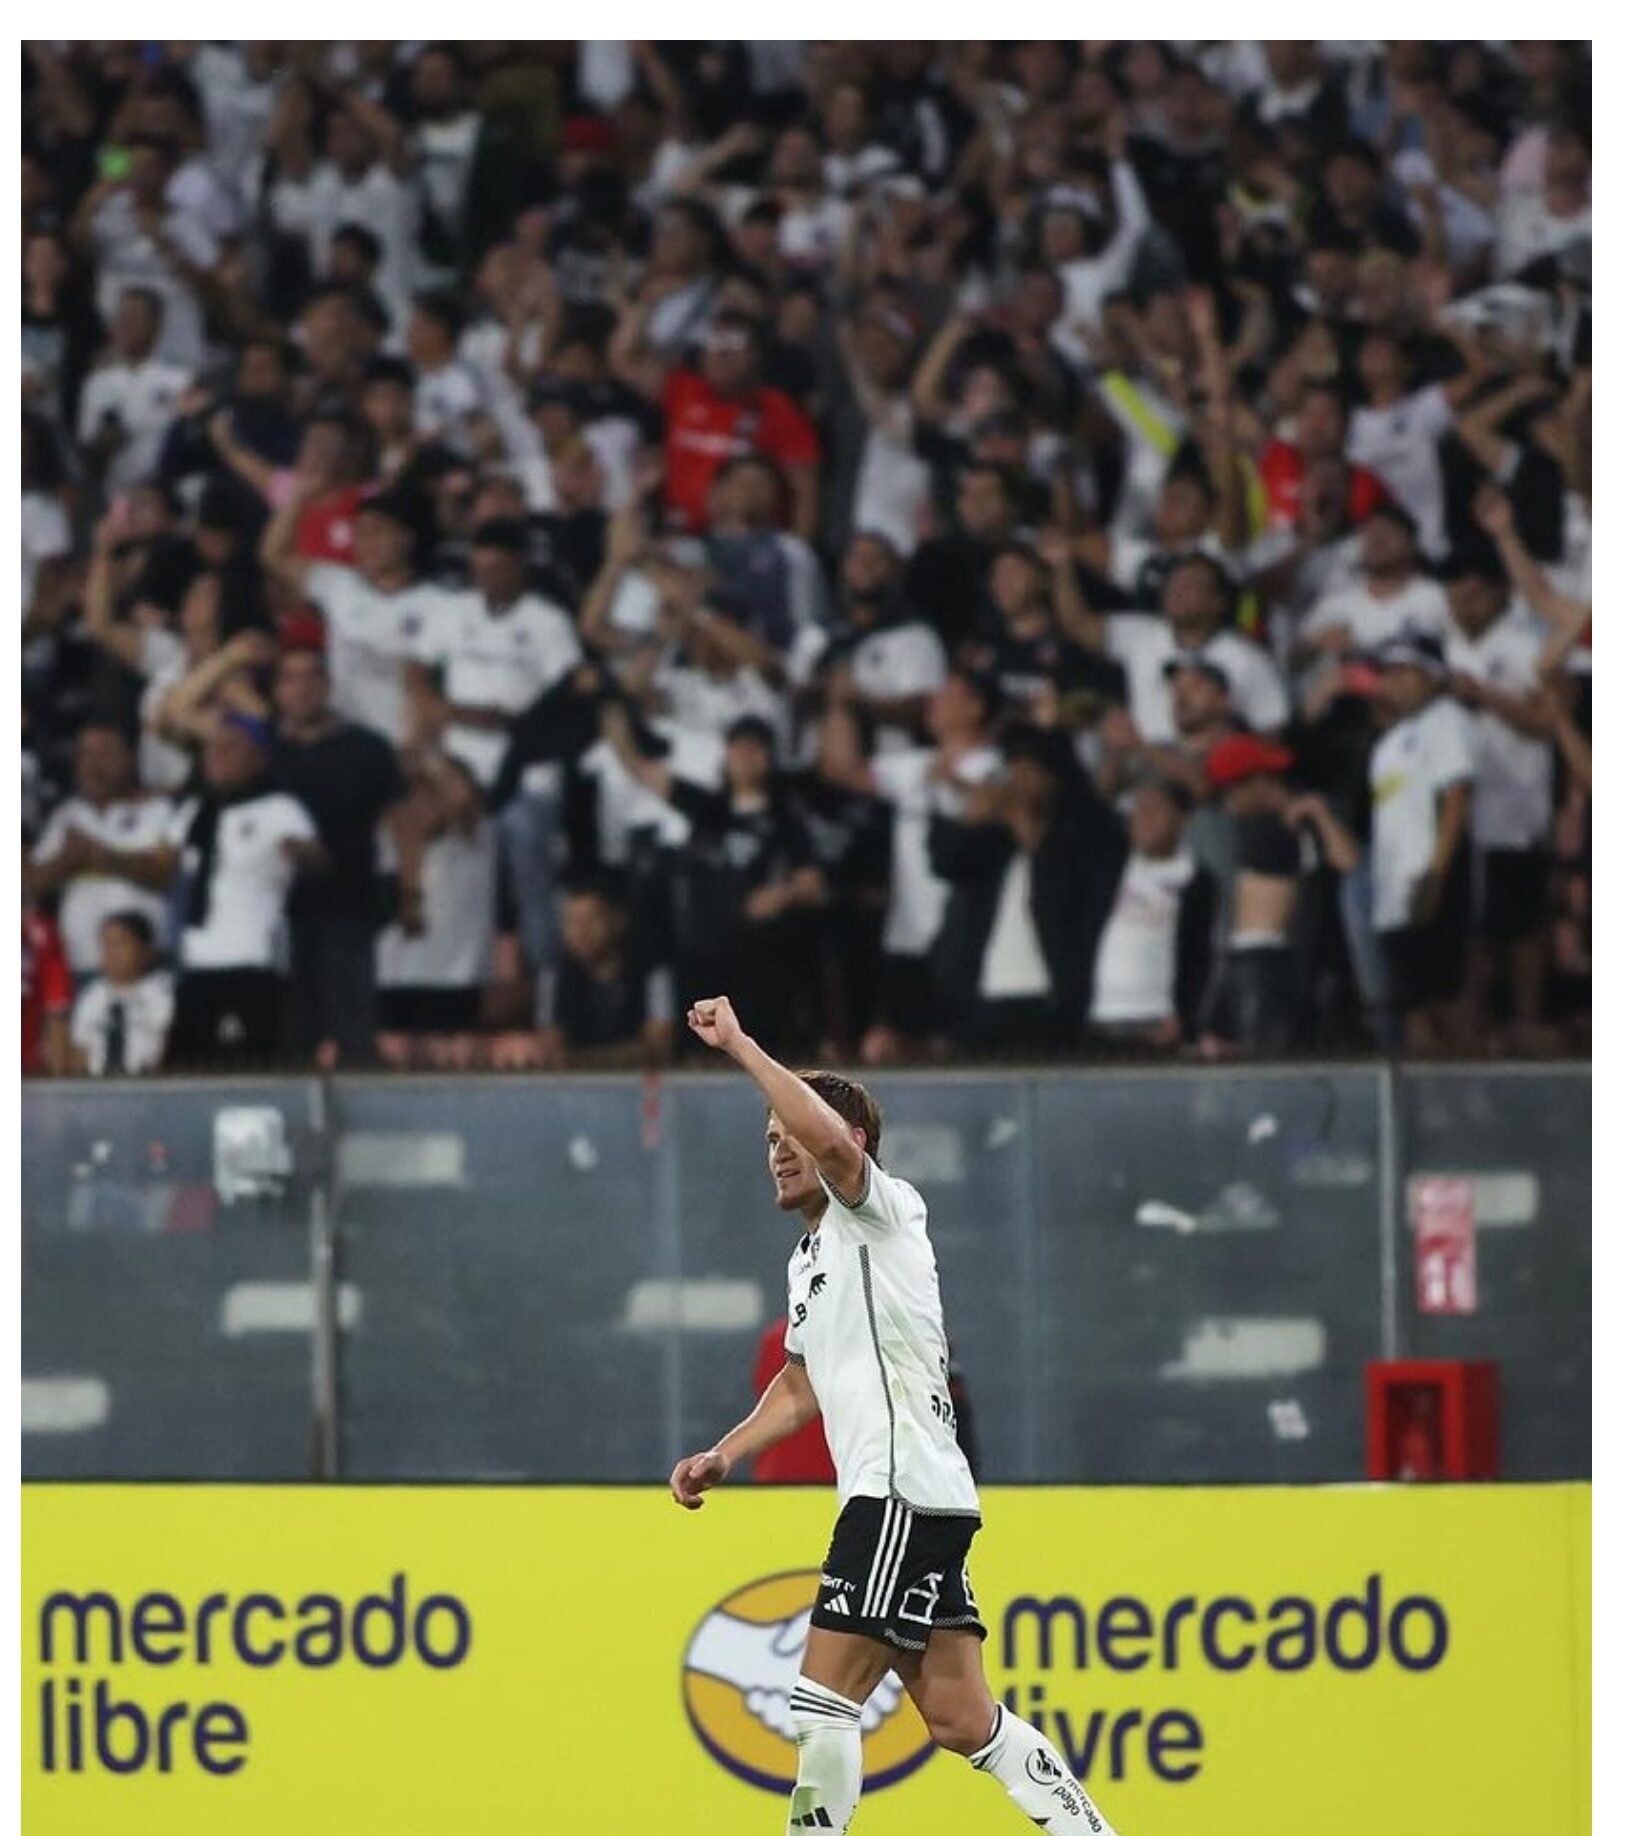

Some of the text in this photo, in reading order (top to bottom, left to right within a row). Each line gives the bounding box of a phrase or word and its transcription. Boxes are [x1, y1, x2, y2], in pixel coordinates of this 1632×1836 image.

[38, 1572, 472, 1670] mercado
[1000, 1572, 1450, 1674] mercado
[40, 1676, 249, 1777] libre
[1003, 1685, 1204, 1784] ivre
[1051, 1786, 1081, 1816] pago
